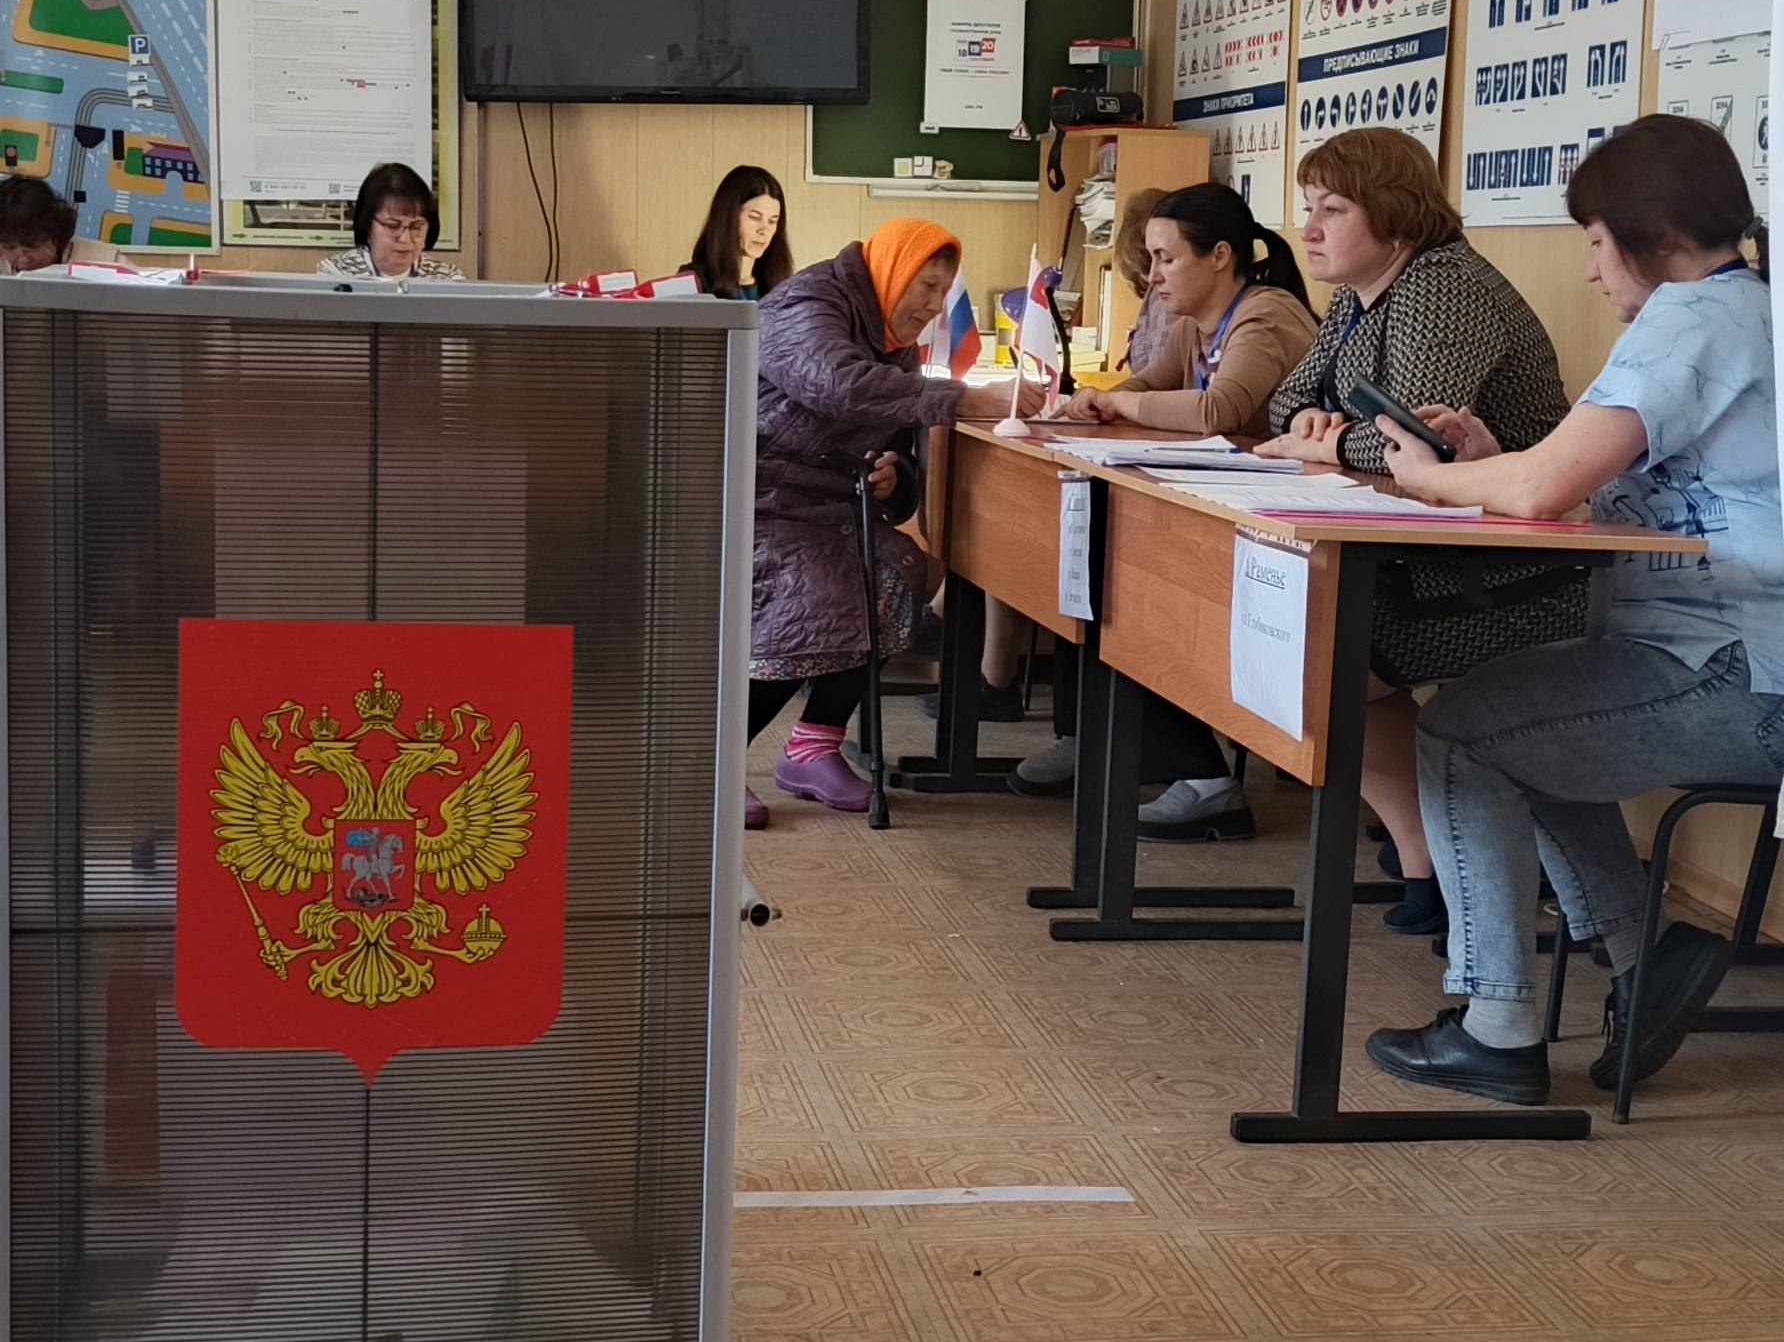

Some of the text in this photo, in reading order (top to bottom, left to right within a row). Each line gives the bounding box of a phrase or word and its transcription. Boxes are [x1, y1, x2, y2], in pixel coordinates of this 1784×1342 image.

[135, 38, 146, 53] P
[981, 40, 993, 50] 20
[1323, 39, 1420, 74] ПРЕДПИСЫВАЮЩИЕ ЗНАКИ
